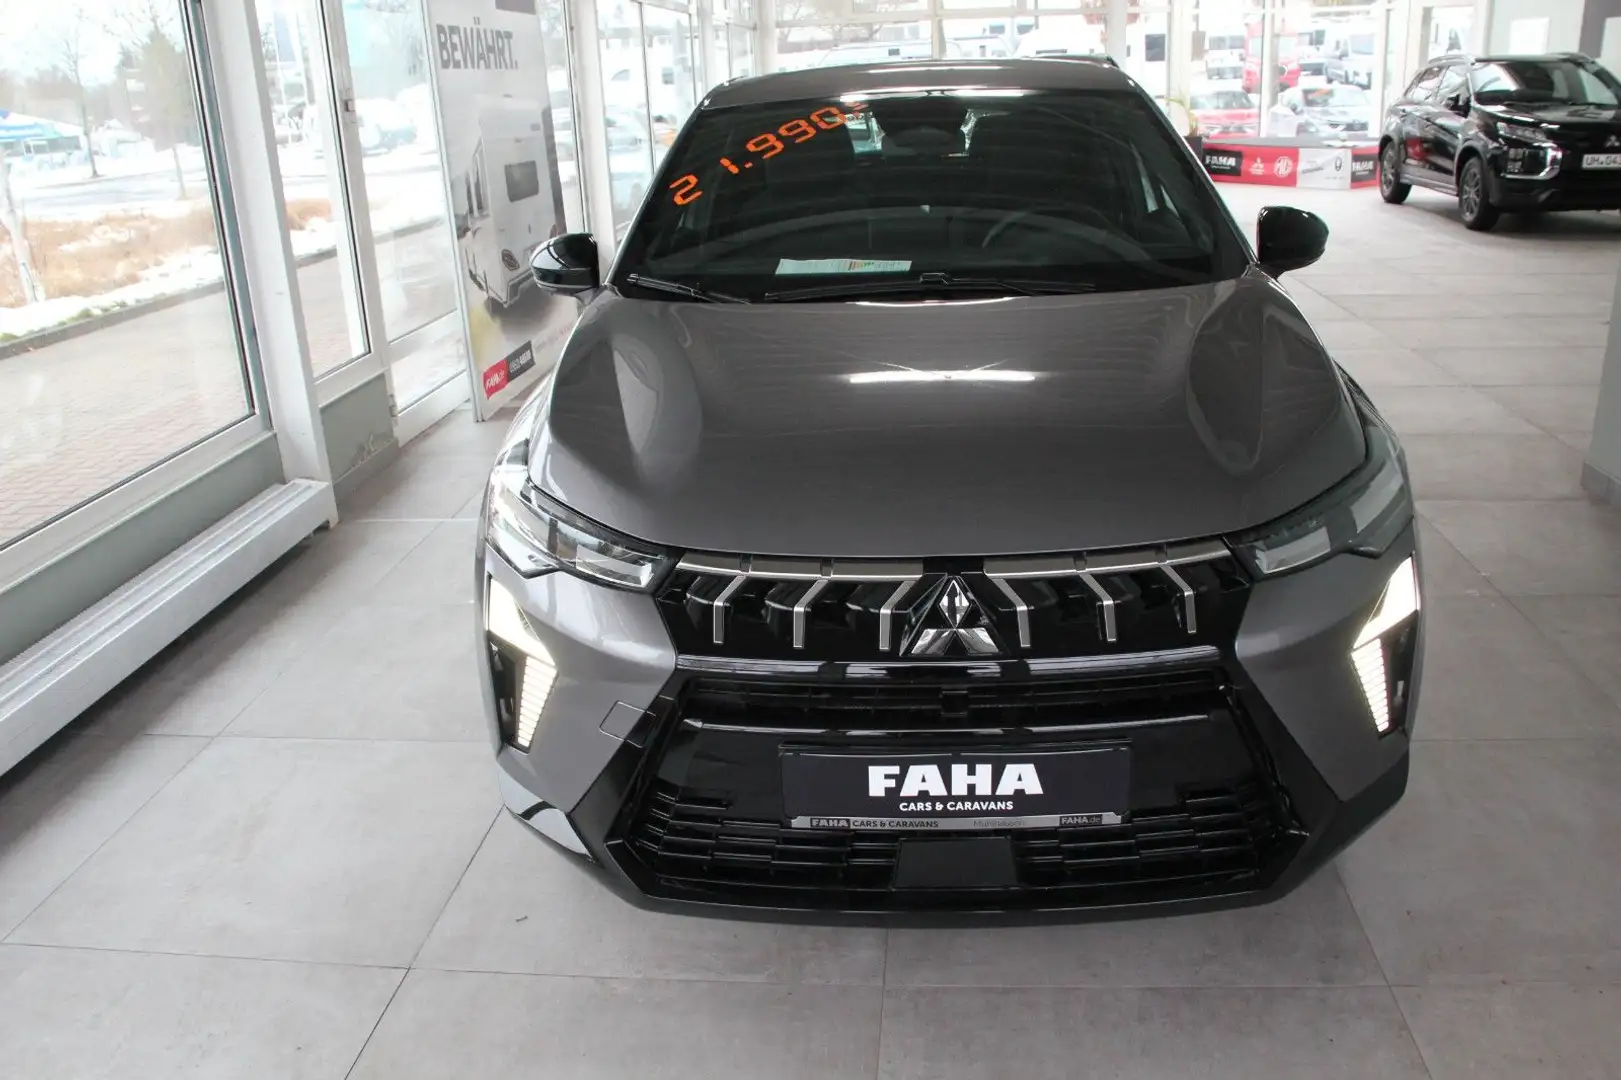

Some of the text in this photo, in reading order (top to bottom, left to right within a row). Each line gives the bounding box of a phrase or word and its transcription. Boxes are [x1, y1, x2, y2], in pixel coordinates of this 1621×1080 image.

[436, 16, 518, 70] BEWÄHRT.
[868, 763, 1044, 797] FAHA
[899, 800, 1014, 812] CARS & CARAVANS
[811, 818, 849, 828] FAHA
[852, 819, 879, 828] CARS
[879, 819, 887, 828] &
[888, 819, 940, 829] CARAVANS
